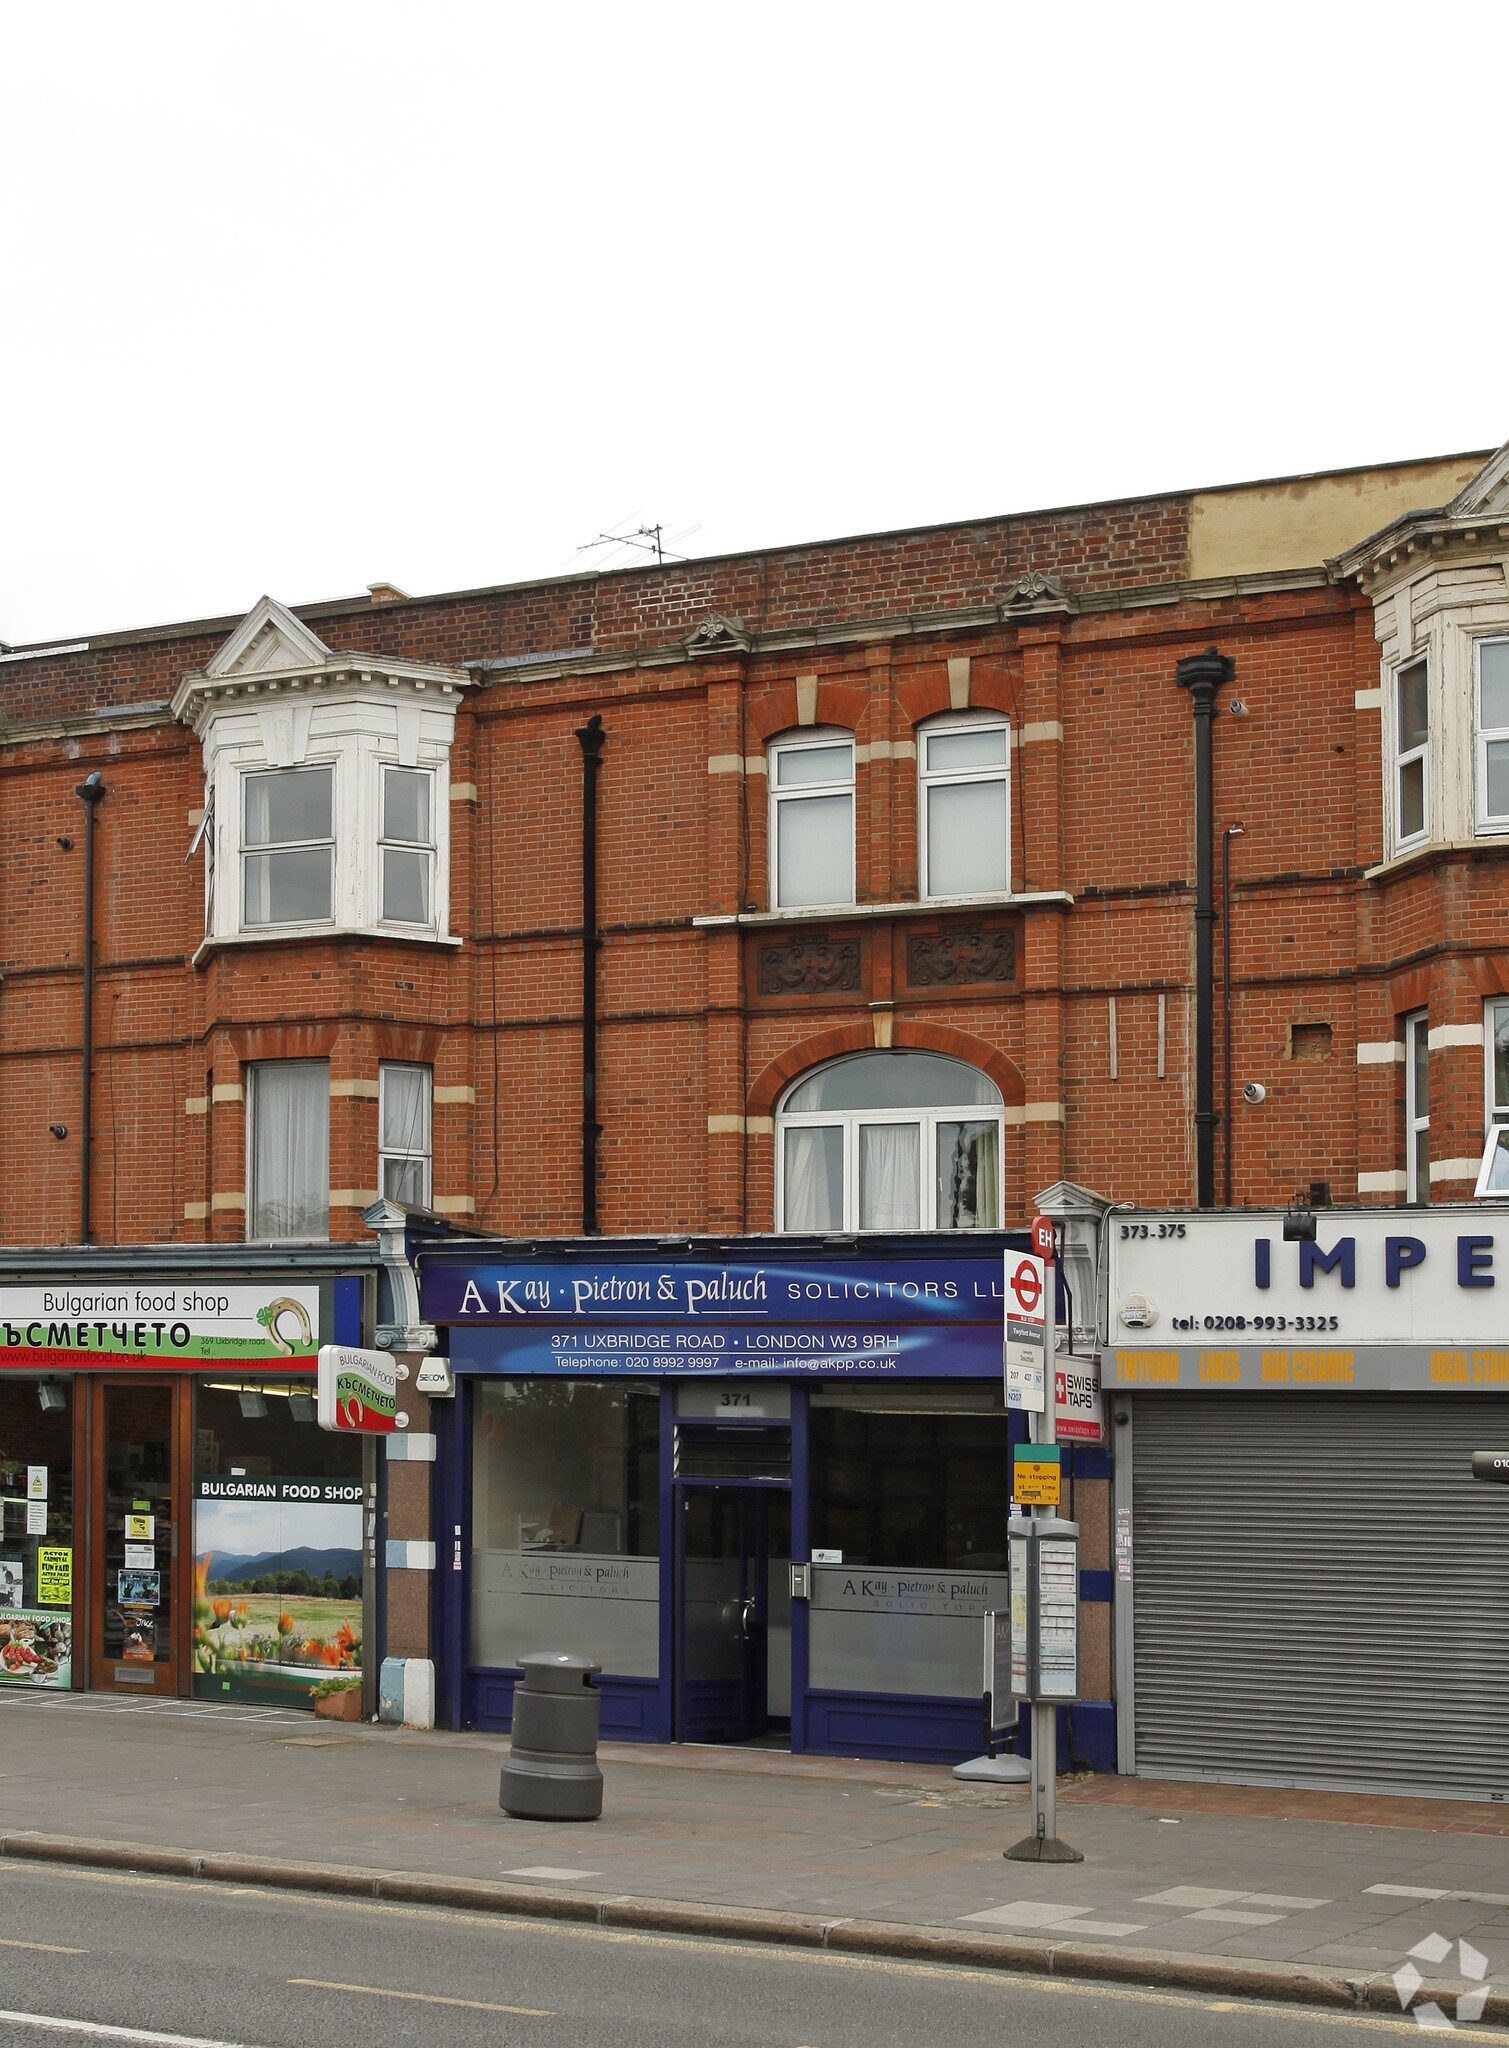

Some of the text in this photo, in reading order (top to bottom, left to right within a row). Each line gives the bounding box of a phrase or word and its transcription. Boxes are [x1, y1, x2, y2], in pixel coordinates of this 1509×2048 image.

[1039, 1228, 1052, 1248] EH
[1120, 1224, 1187, 1239] 373-375
[1255, 1236, 1495, 1288] IMPE
[459, 1280, 490, 1314] A
[496, 1280, 550, 1314] Kay
[571, 1276, 651, 1314] Pietron
[657, 1275, 678, 1300] &
[685, 1270, 767, 1314] Paluch
[788, 1281, 958, 1299] SOLICITORS
[44, 1291, 229, 1317] Bulgarian food shop
[1172, 1315, 1339, 1331] tel: 0208-993-3325
[2, 1322, 191, 1348] ЪСМЕТЧЕТО
[201, 1337, 266, 1347] 369 Uxbridge road
[551, 1335, 899, 1348] 371 UXBRIDGE ROAD LONDON W3 9RH
[1, 1349, 147, 1366] www.bulgarianfood.co.uk
[555, 1357, 896, 1371] Telephone: 020 8992 9997 e-mail: info@akpp.co.uk
[1115, 1352, 1179, 1381] TWYFORD
[1262, 1351, 1289, 1381] RAK
[1292, 1350, 1354, 1382] CERAMIC
[340, 1355, 377, 1377] BULGARIAN
[378, 1369, 395, 1386] FOOD
[1010, 1371, 1019, 1379] 207
[1430, 1350, 1470, 1383] IDEAL
[419, 1374, 445, 1382] SECOM
[1067, 1374, 1099, 1392] SWISS
[337, 1378, 395, 1409] КЪСМЕТЧЕТО
[721, 1393, 751, 1406] 371
[1068, 1391, 1092, 1408] TAPS
[201, 1483, 363, 1500] BULGARIAN FOOD SHOP
[842, 1579, 857, 1595] A
[861, 1580, 888, 1596] Kay
[937, 1582, 946, 1593] &
[32, 1614, 51, 1622] FOOD
